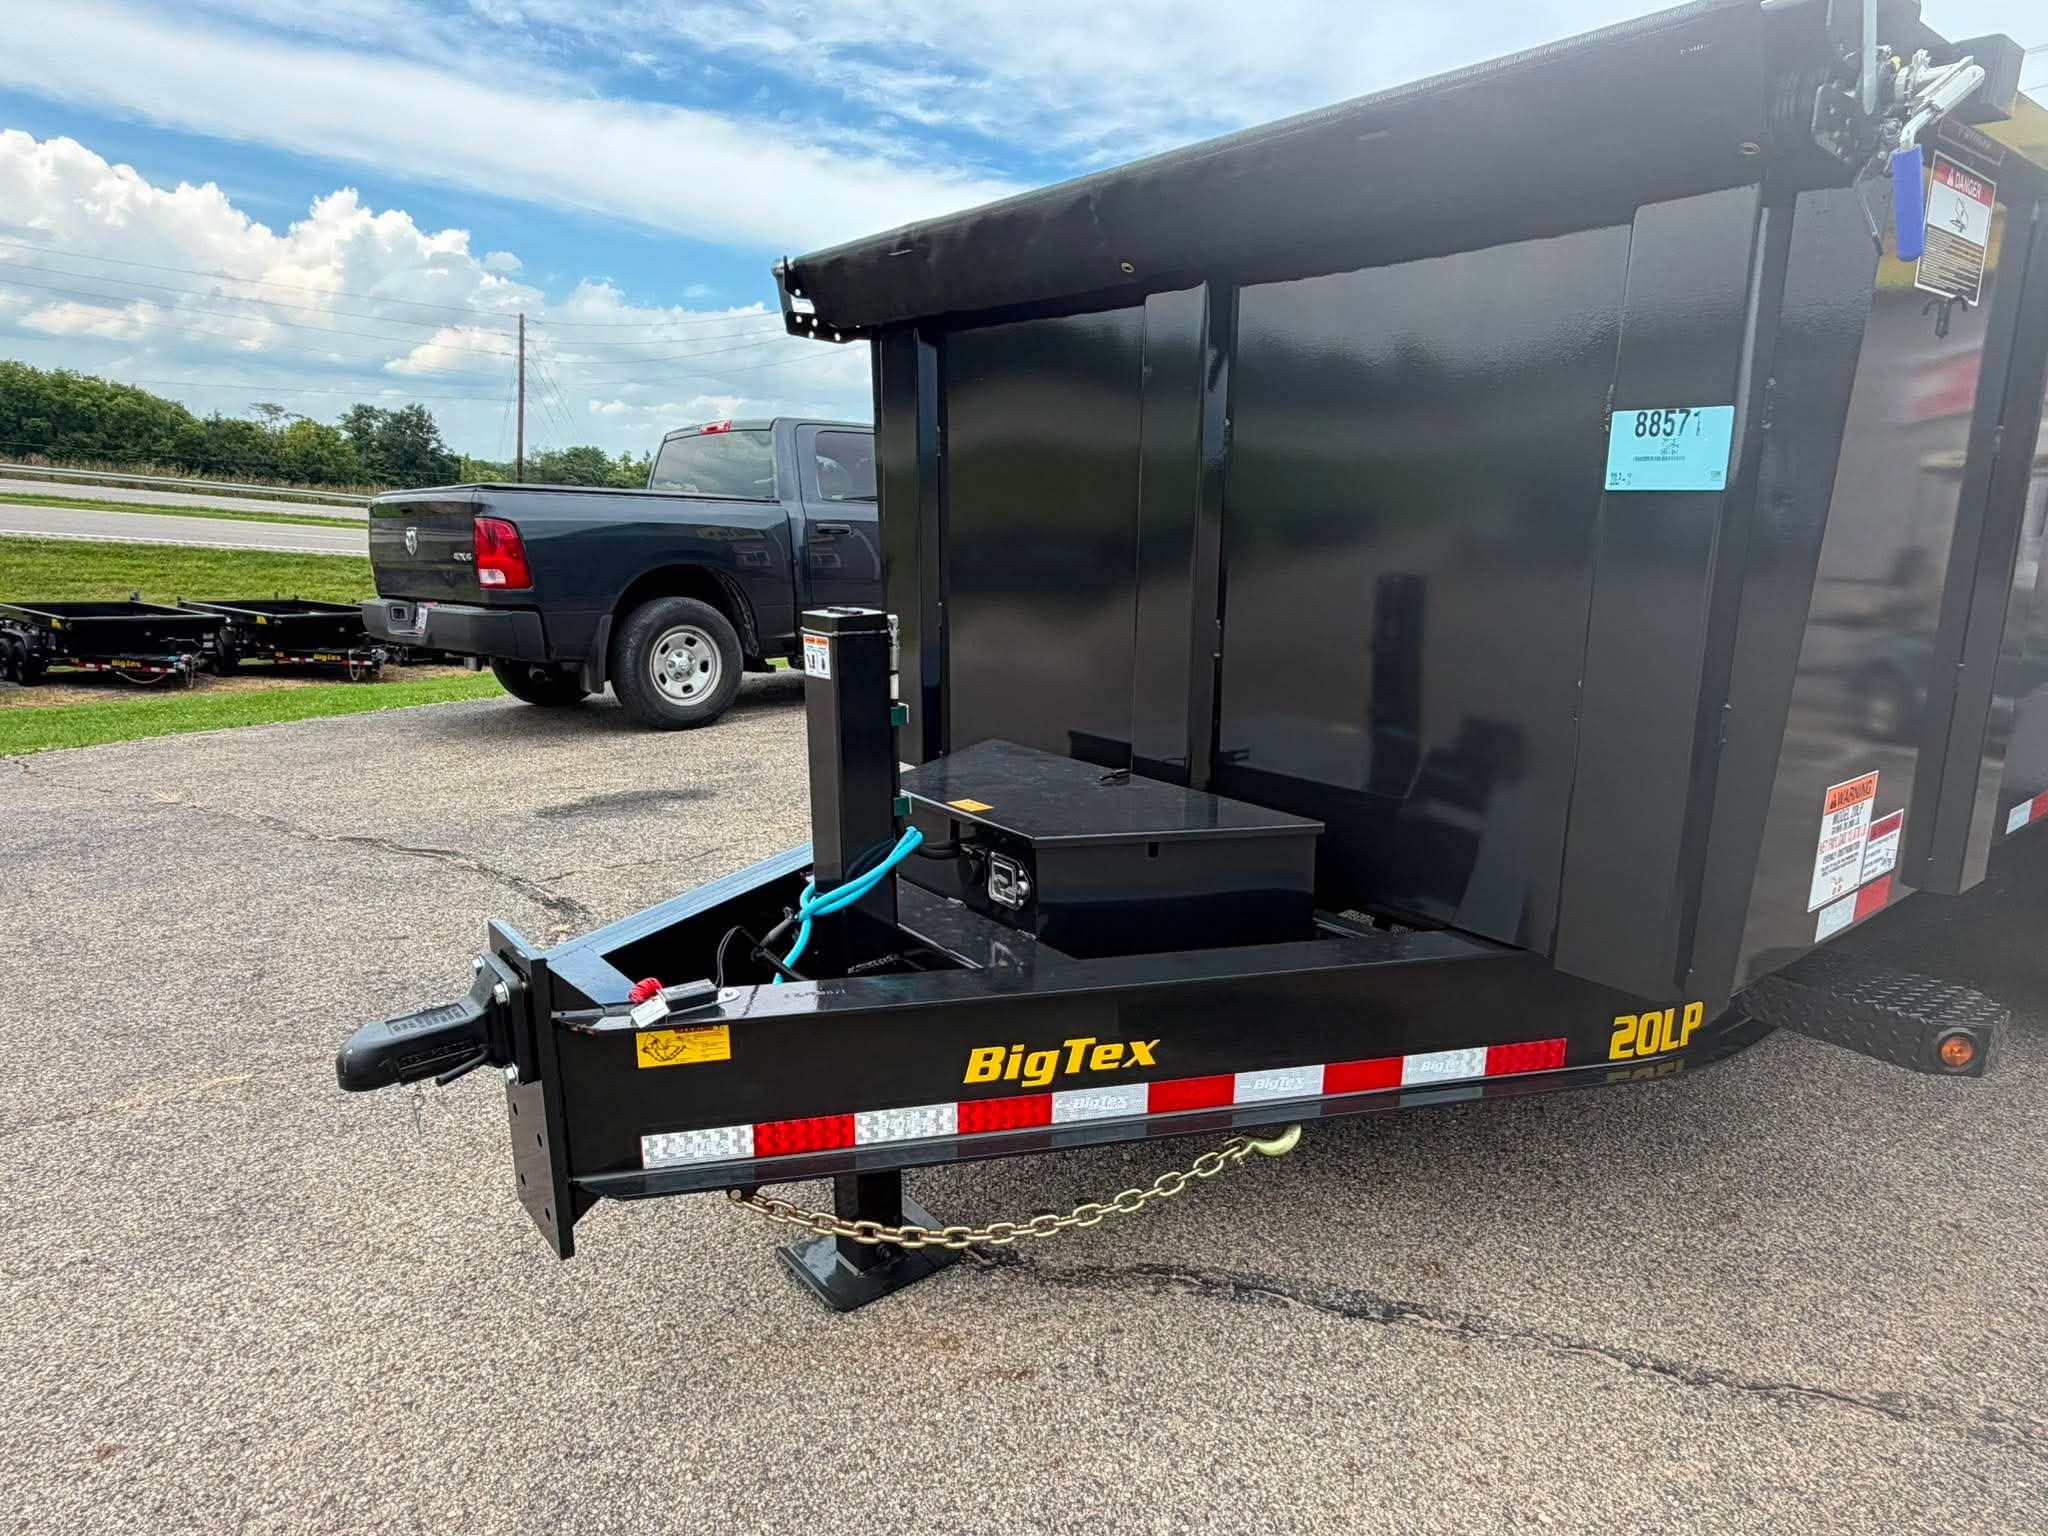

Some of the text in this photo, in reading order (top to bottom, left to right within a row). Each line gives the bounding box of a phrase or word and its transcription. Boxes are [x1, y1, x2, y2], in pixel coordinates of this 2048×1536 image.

[1954, 171, 1983, 199] DANGER
[1635, 409, 1702, 438] 88571
[1837, 780, 1873, 806] WARNING
[1608, 1001, 1704, 1060] 20LP
[963, 1037, 1161, 1087] BigTex
